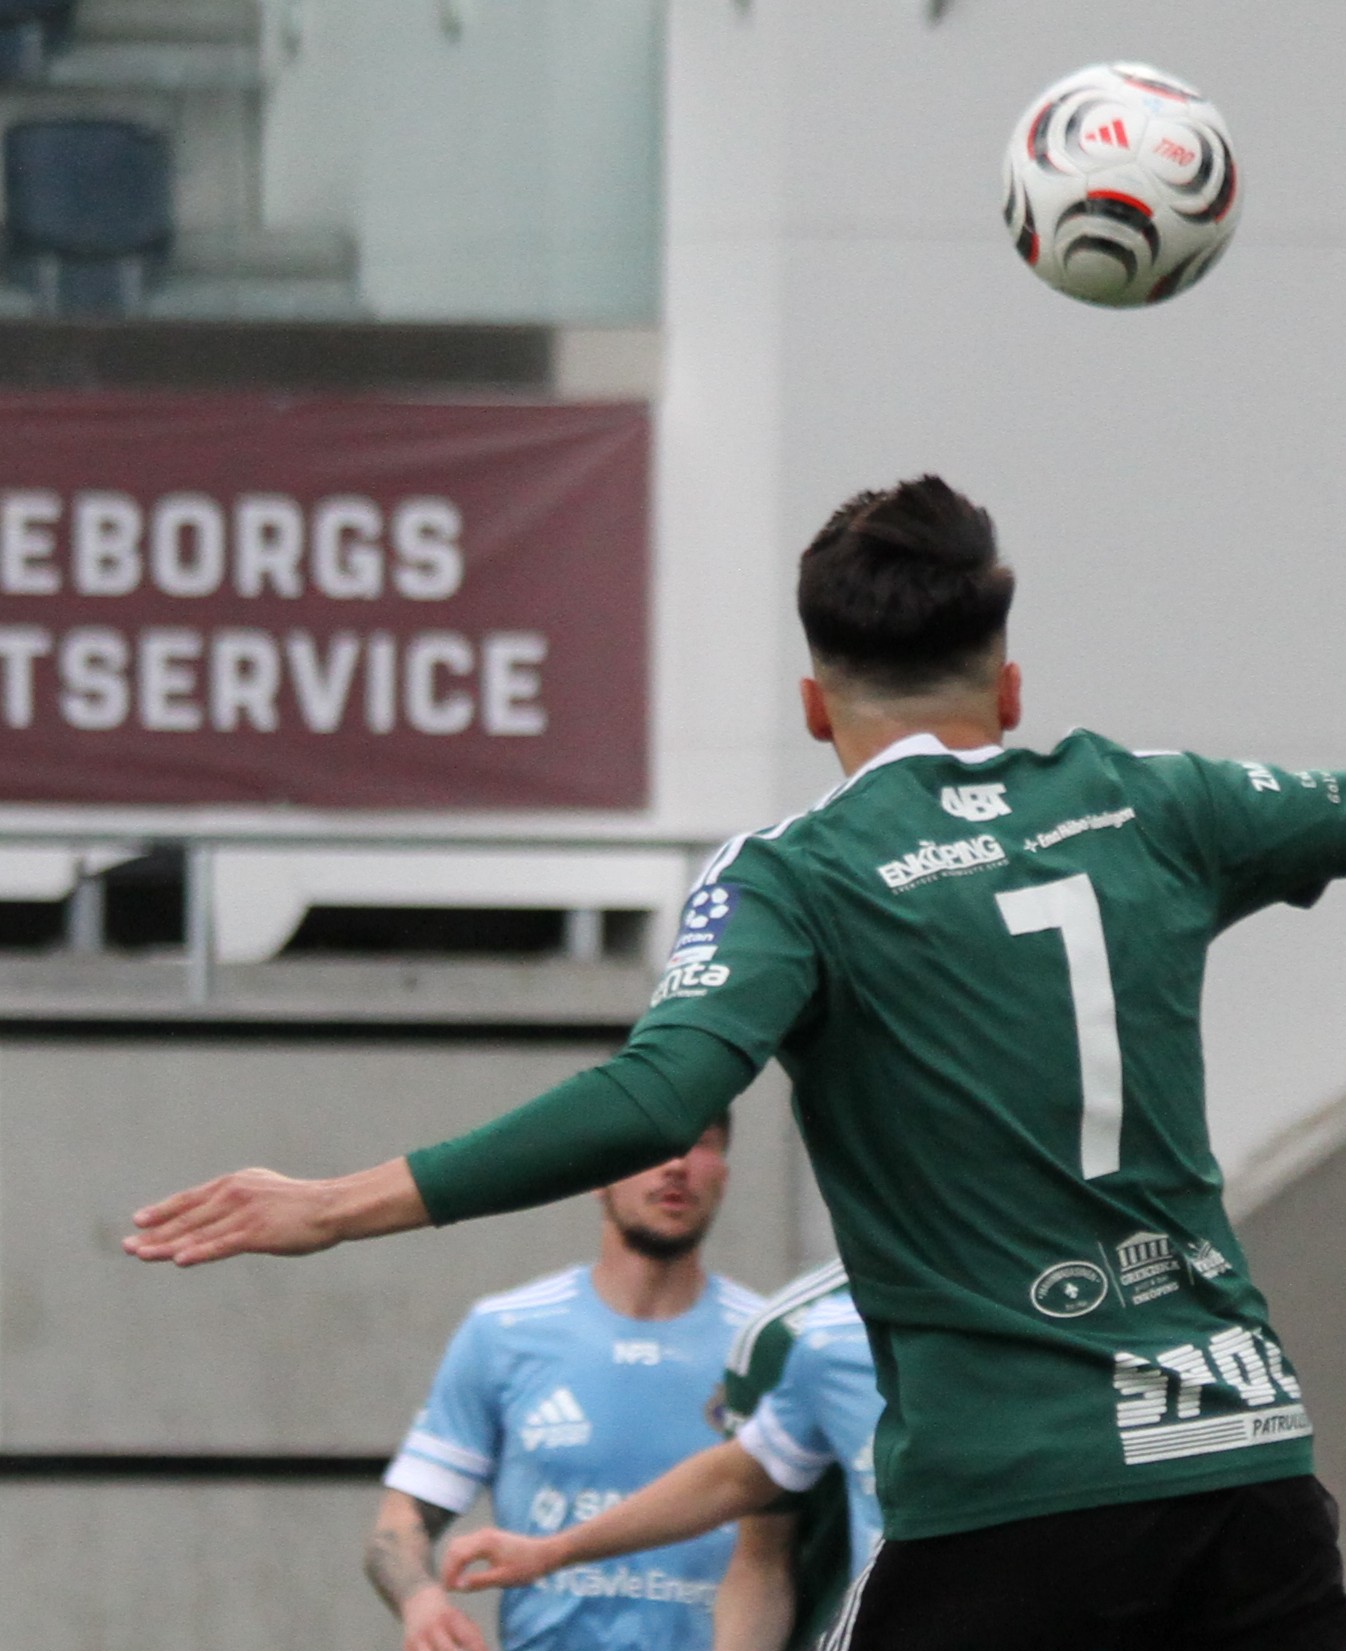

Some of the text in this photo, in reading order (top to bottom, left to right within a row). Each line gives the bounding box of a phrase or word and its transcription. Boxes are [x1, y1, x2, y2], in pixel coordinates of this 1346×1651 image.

[0, 490, 464, 601] EBORGS
[0, 625, 550, 736] TSERVICE
[877, 834, 1006, 889] ENKÖPING
[995, 873, 1125, 1181] 7
